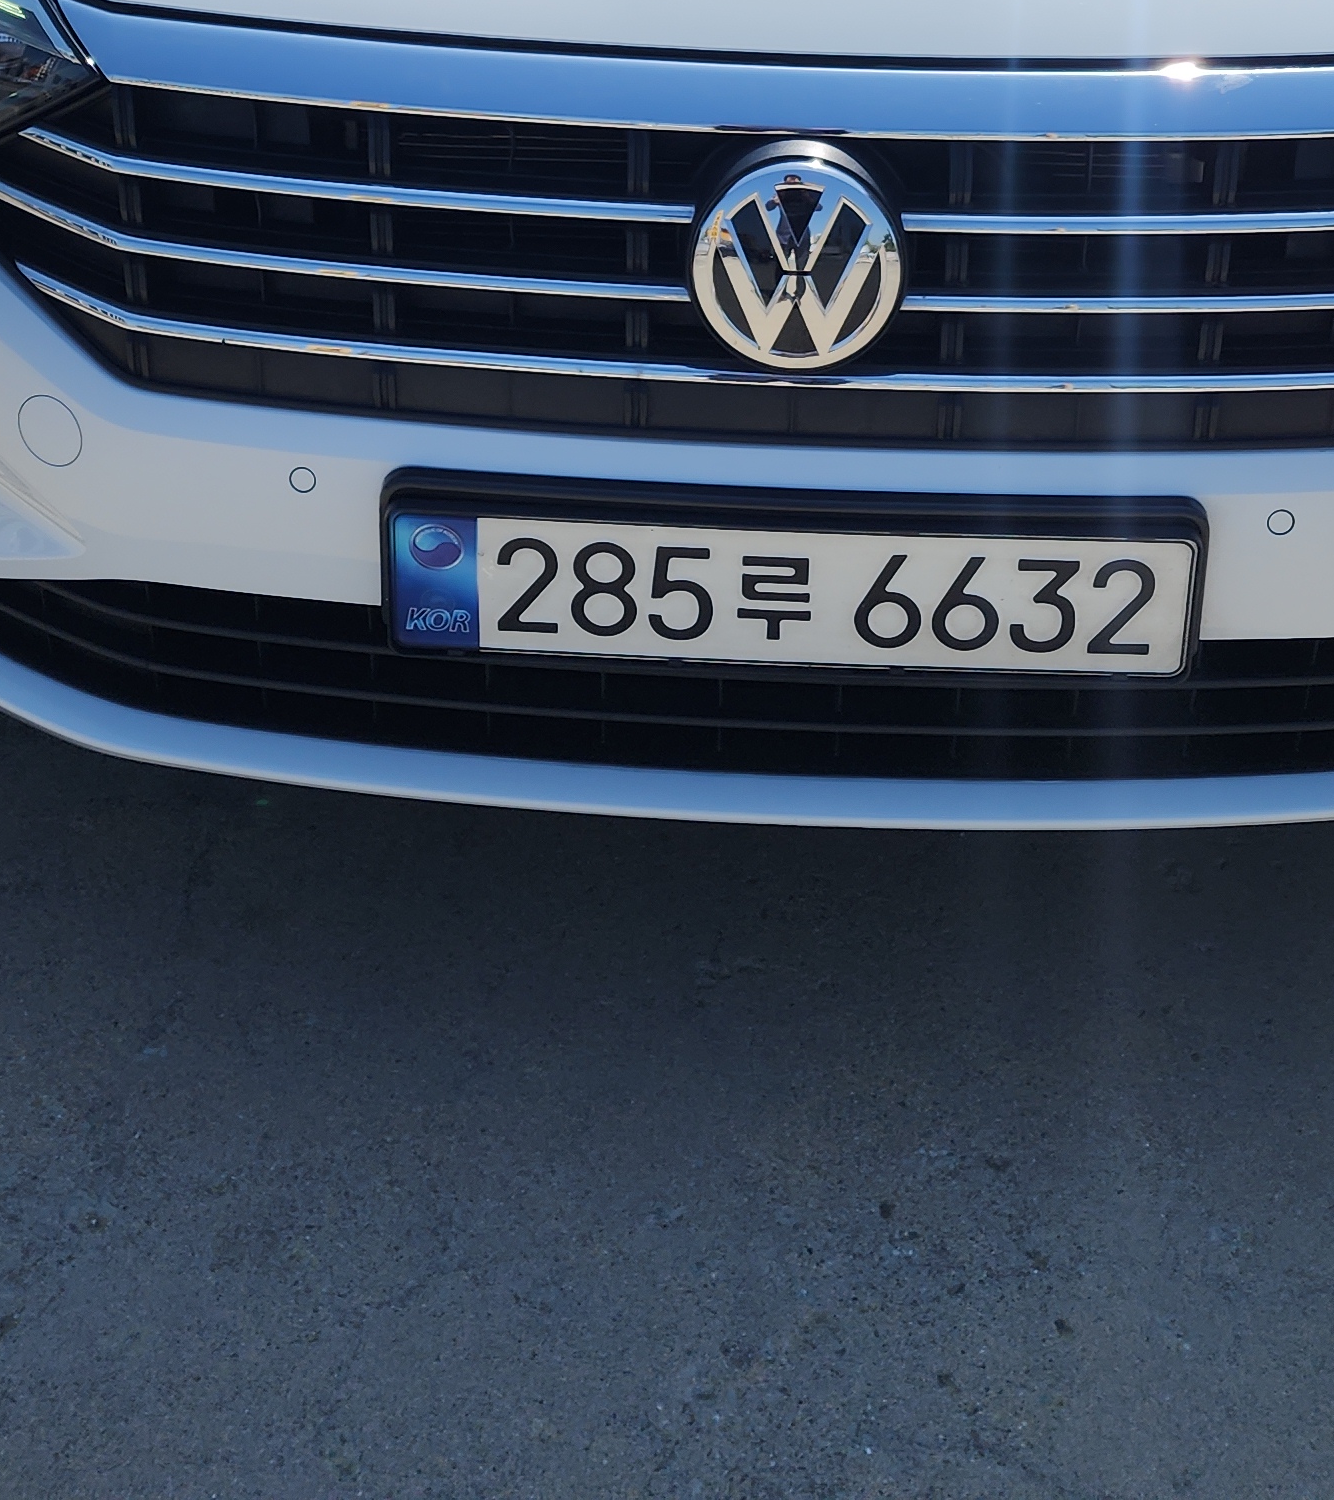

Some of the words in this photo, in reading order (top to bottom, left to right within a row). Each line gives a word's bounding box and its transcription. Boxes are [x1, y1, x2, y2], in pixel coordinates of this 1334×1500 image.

[406, 607, 471, 633] KOR
[497, 537, 813, 642] 285루
[853, 554, 1158, 656] 6632
